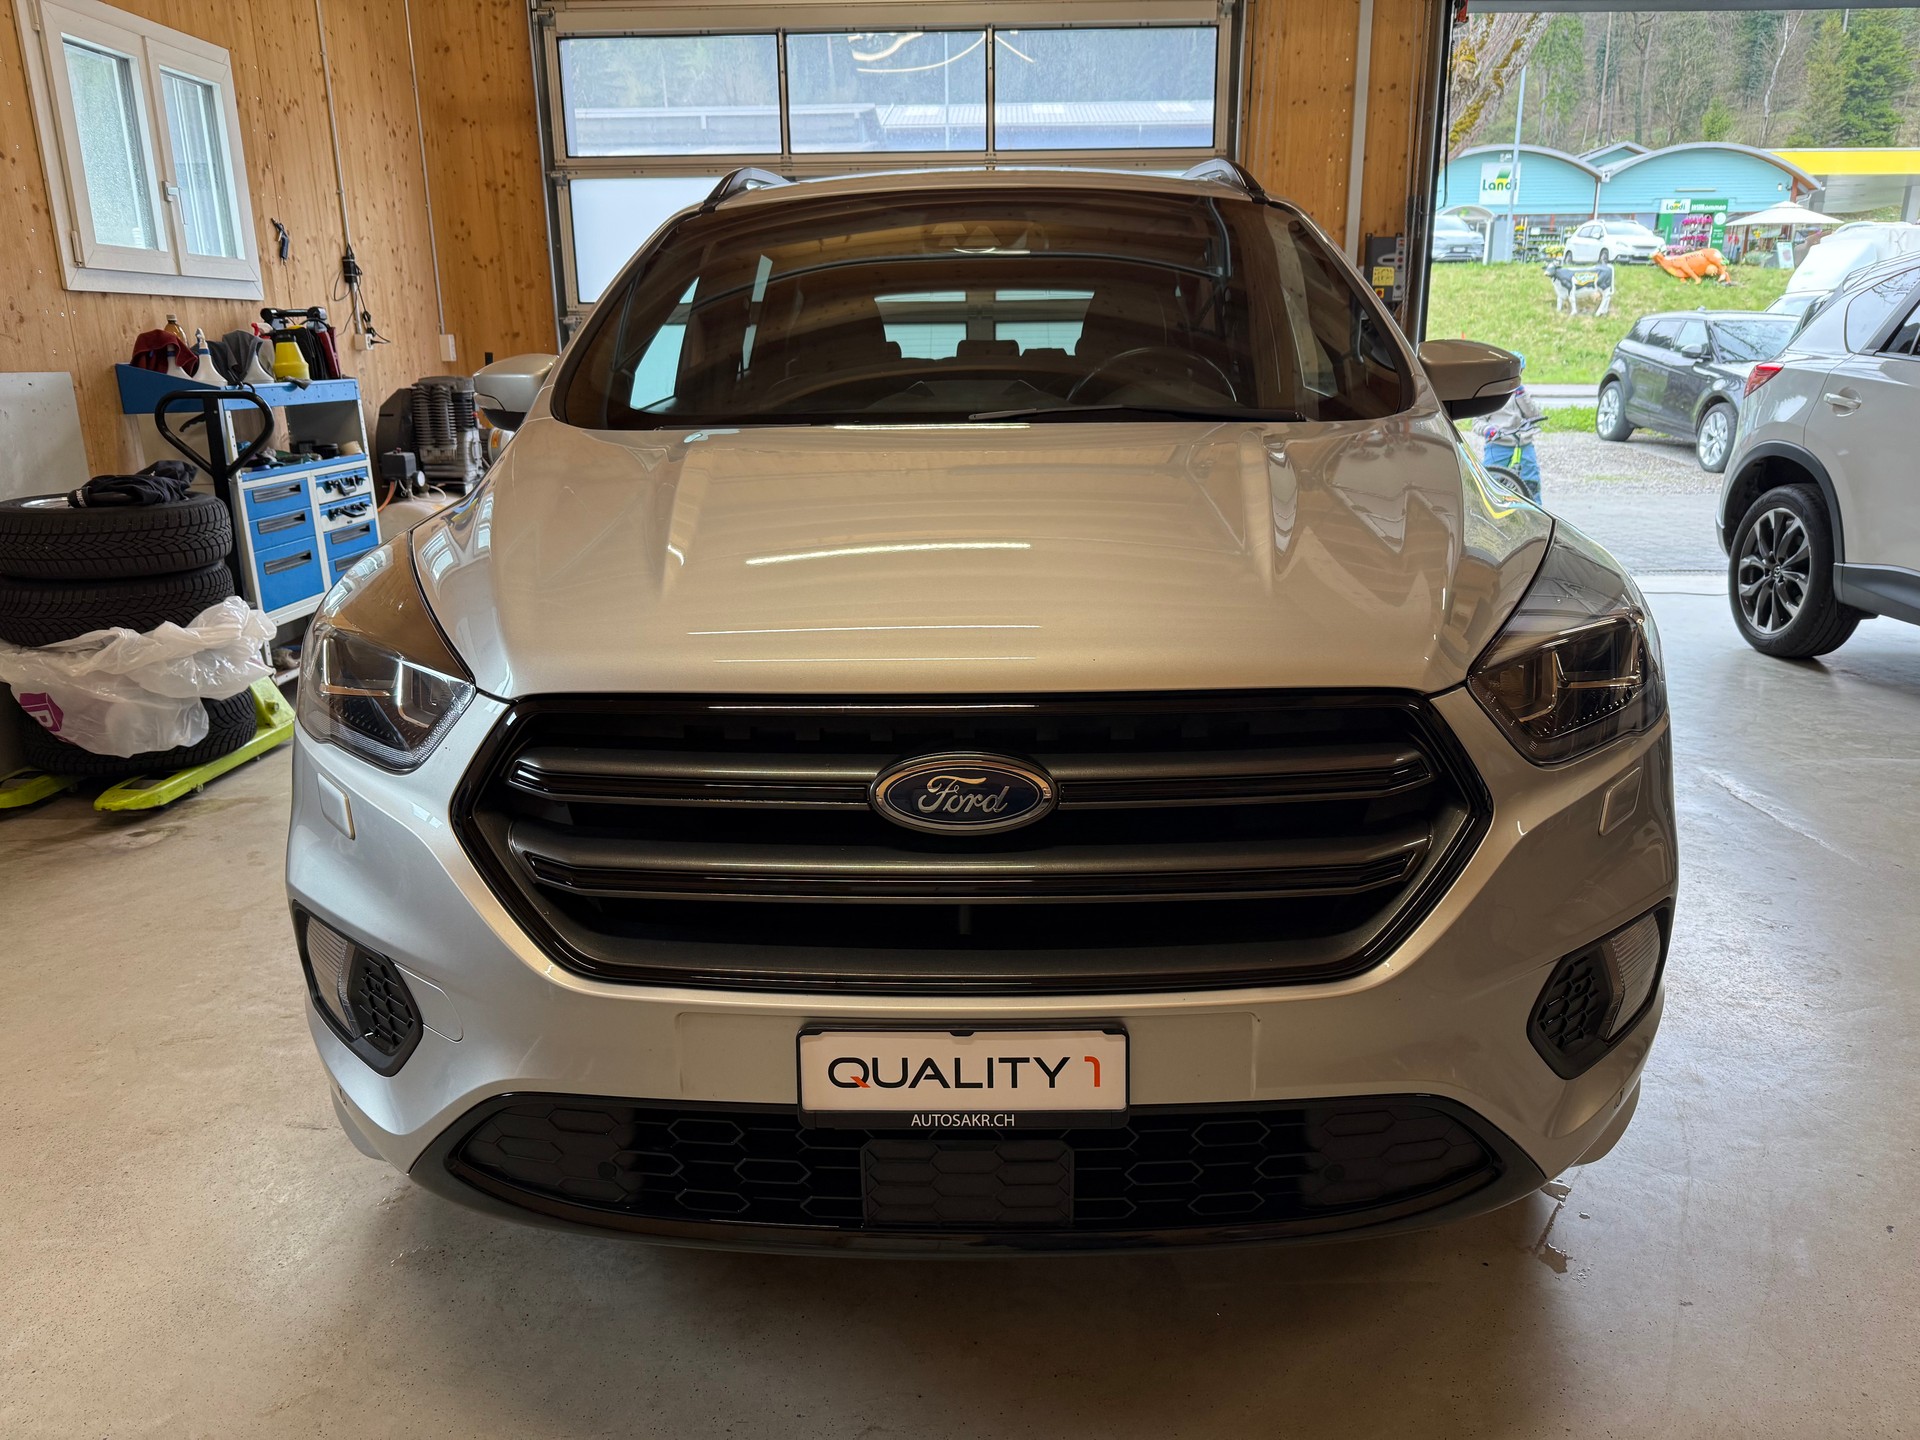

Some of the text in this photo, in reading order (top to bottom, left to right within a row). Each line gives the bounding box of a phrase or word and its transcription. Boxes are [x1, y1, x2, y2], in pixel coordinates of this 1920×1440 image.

[1482, 178, 1518, 191] Landi
[1666, 203, 1686, 211] Landi
[918, 775, 1010, 813] Ford
[828, 1056, 1101, 1089] QUALITY 1
[911, 1113, 1015, 1127] AUTOSAKR.CH
